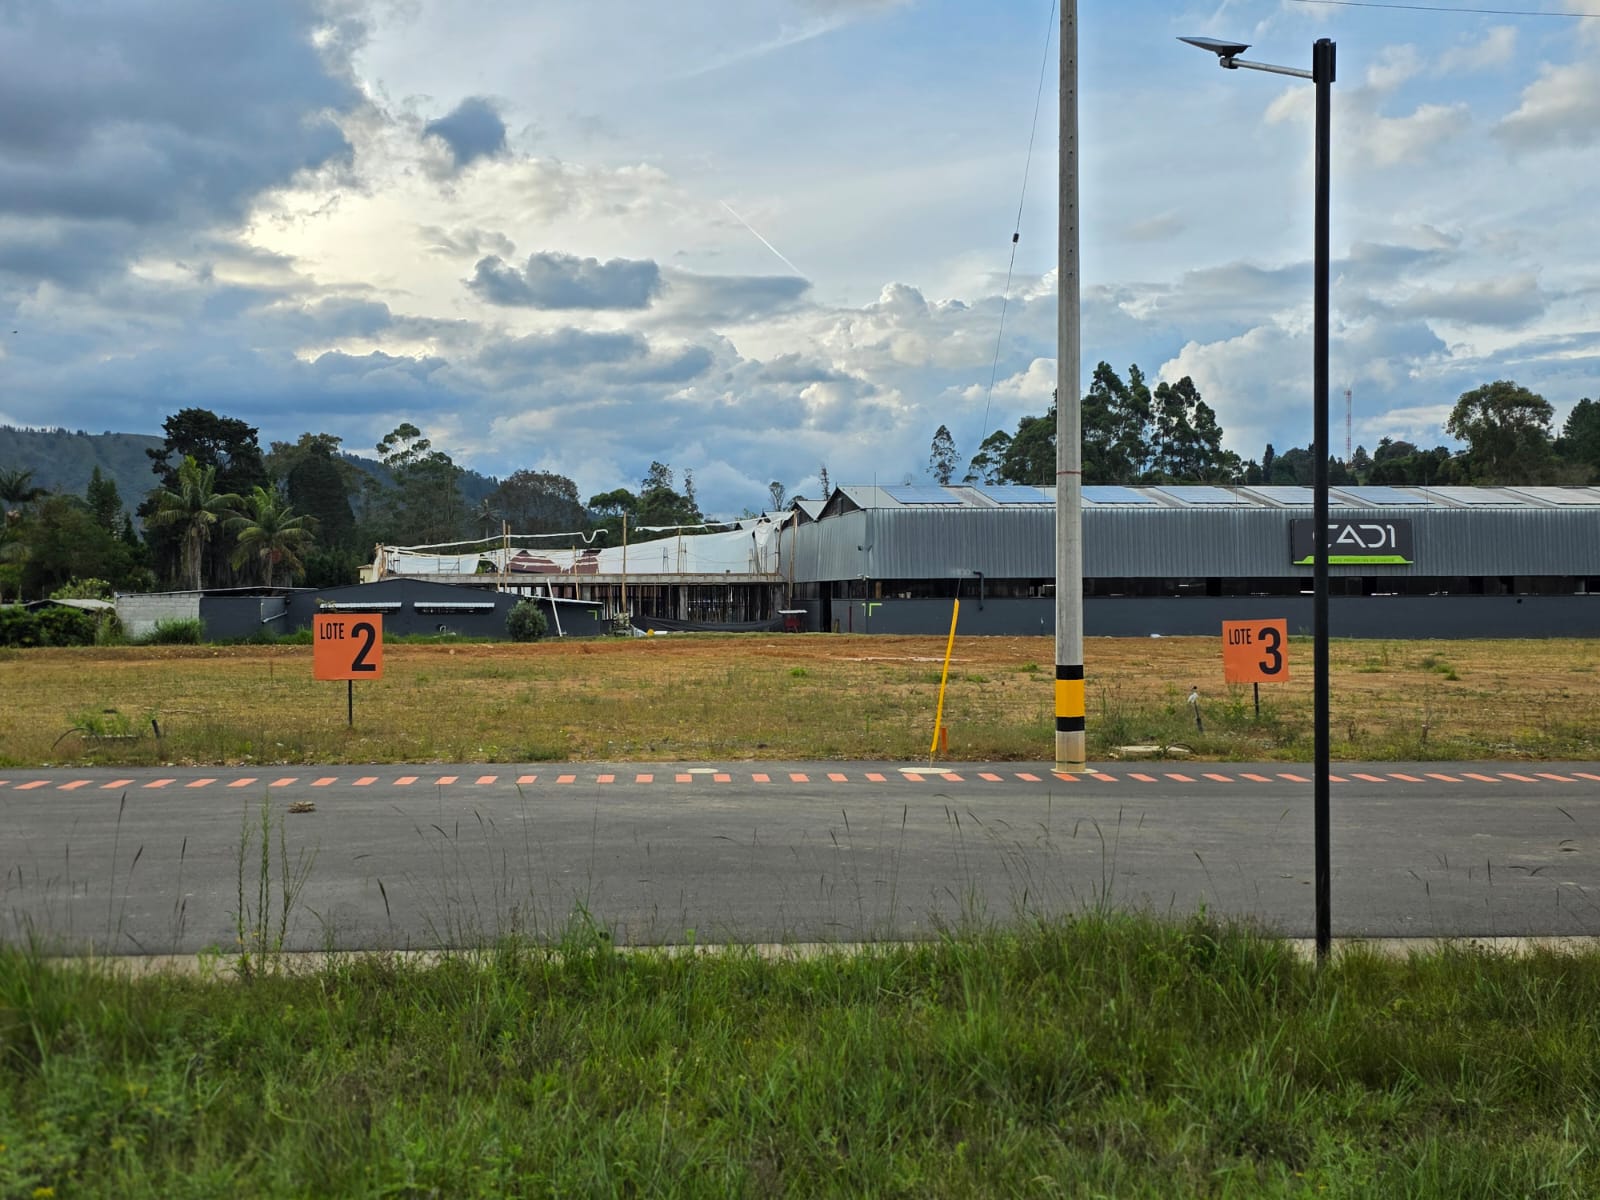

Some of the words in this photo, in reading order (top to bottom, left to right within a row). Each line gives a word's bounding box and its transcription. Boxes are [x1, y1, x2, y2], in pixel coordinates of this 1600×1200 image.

[320, 622, 345, 640] LOTE
[351, 622, 376, 672] 2
[1228, 628, 1252, 646] LOTE
[1257, 626, 1283, 675] 3
